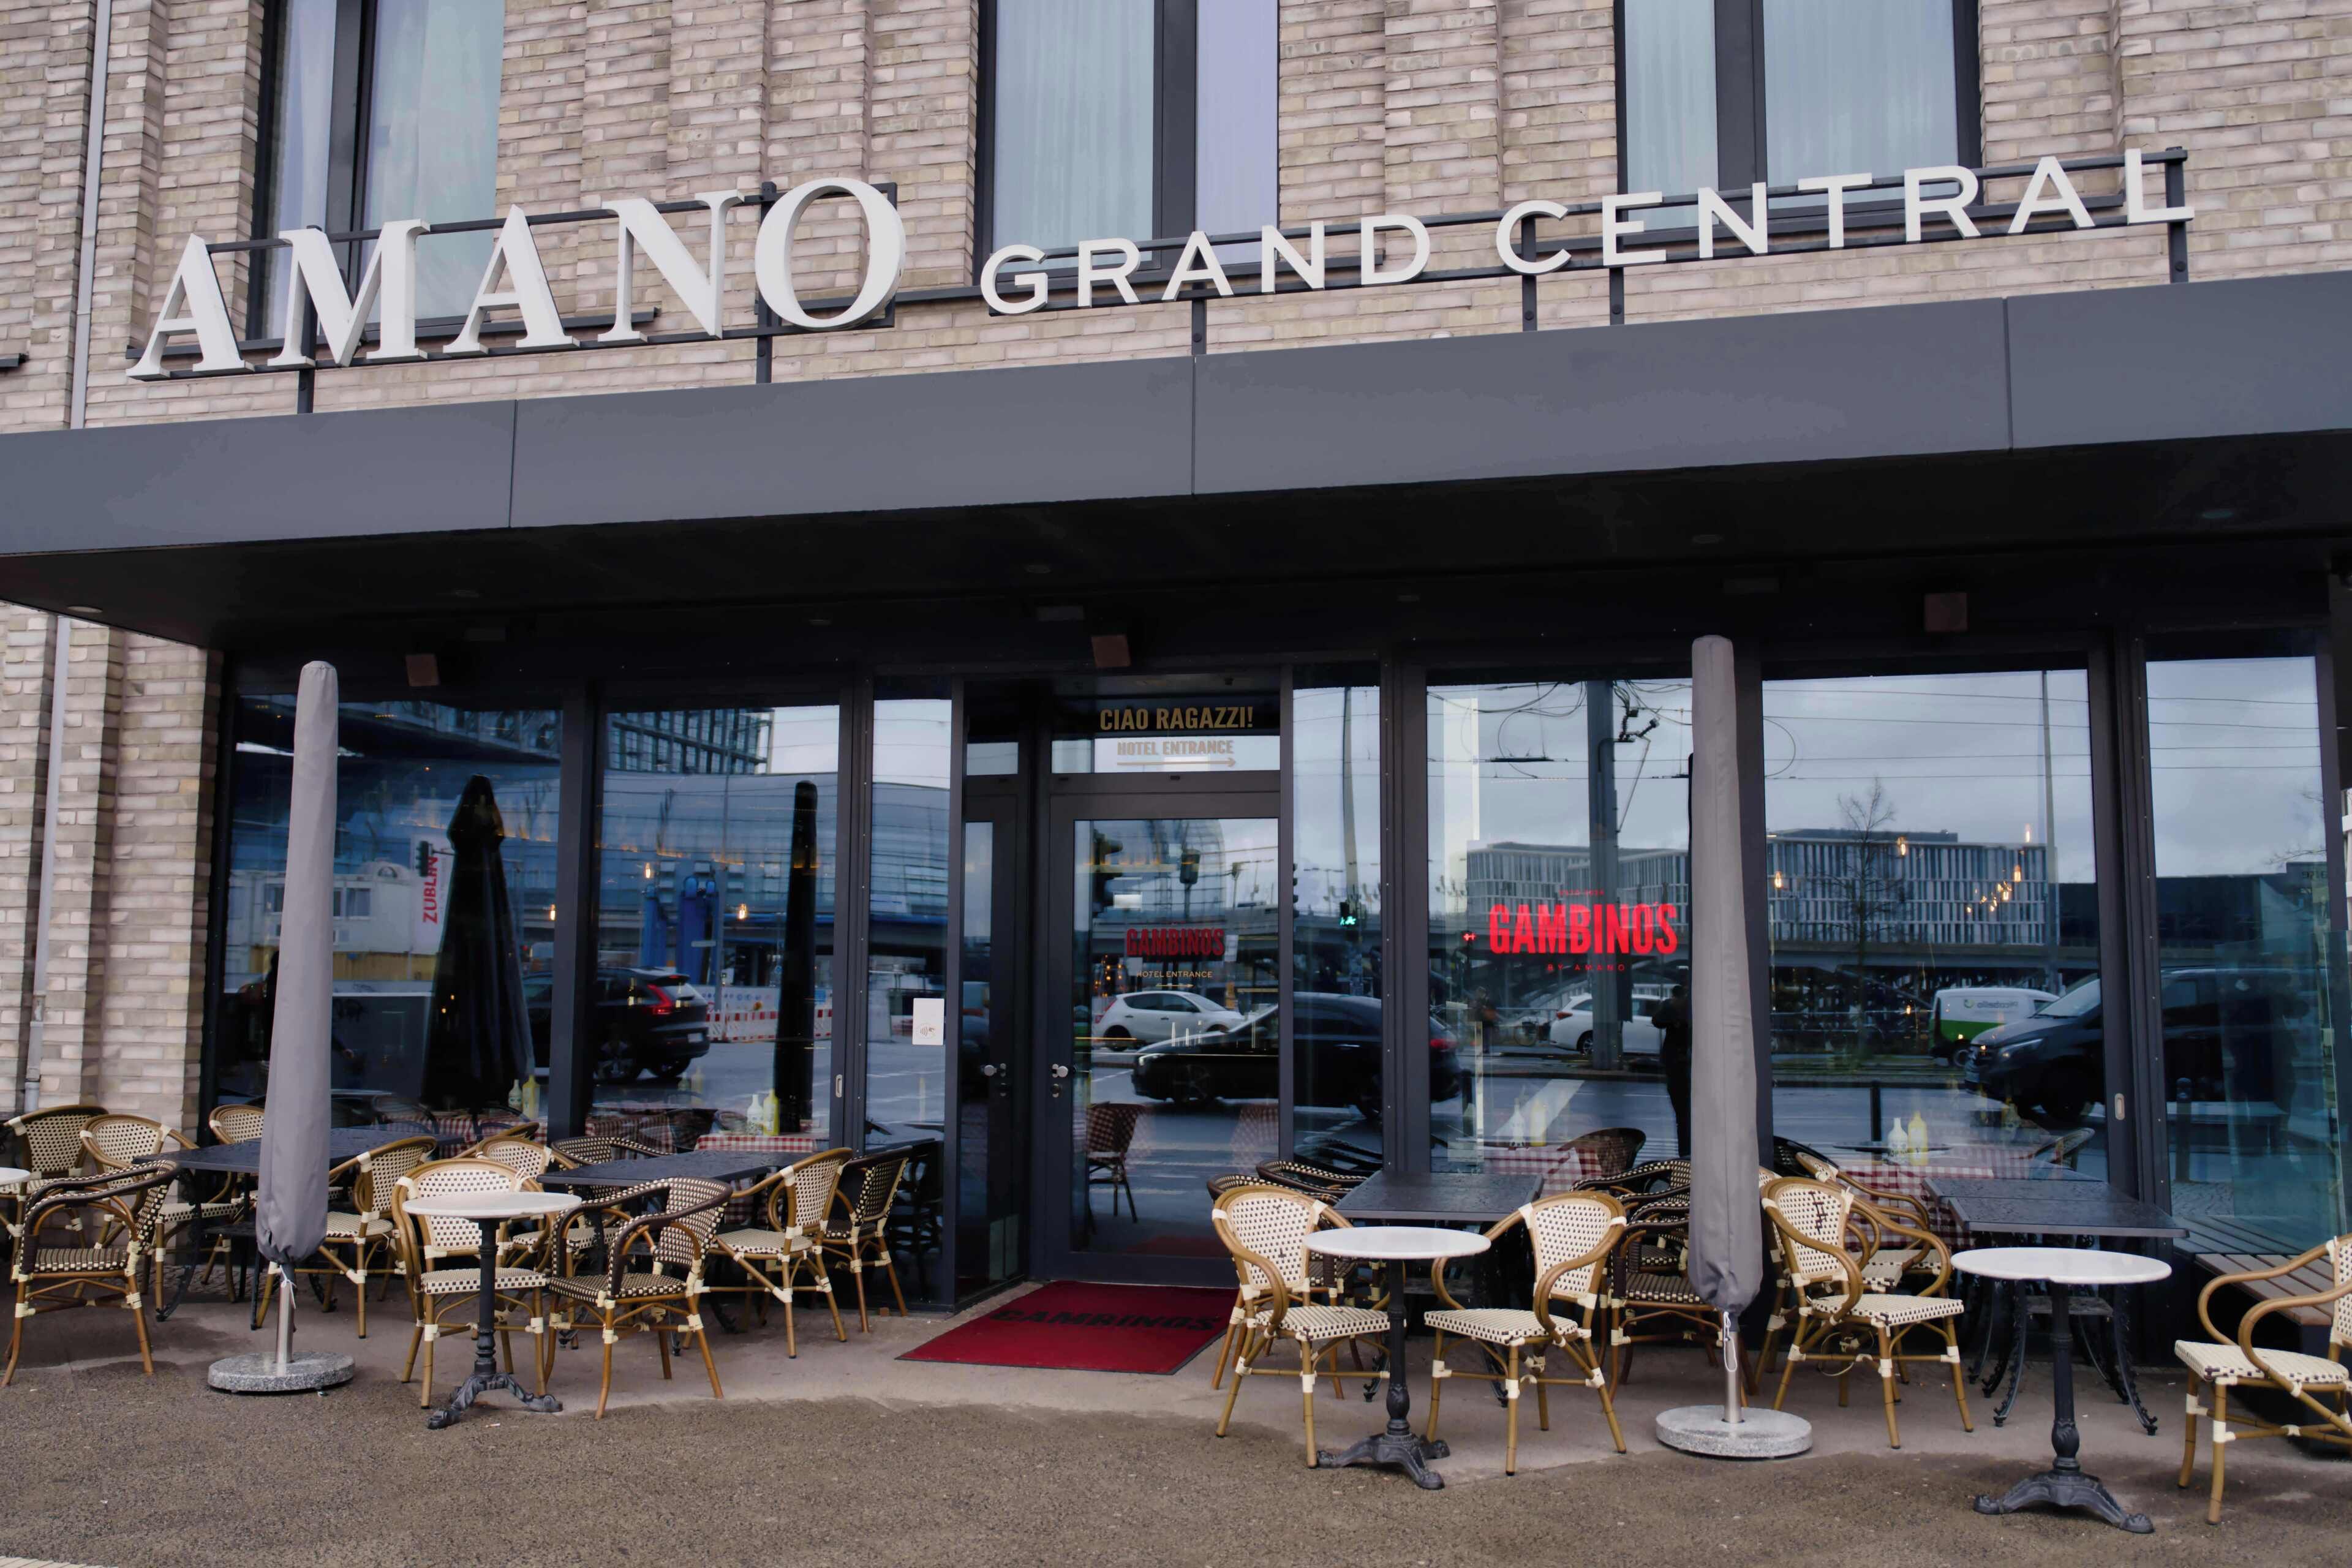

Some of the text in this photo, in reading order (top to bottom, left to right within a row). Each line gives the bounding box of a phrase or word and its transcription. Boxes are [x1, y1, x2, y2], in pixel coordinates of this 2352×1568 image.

[126, 148, 2195, 381] AMANO GRAND CENTRAL
[1100, 706, 1254, 731] CIAO RAGAZZI!
[1117, 739, 1235, 756] HOTEL ENTRANCE
